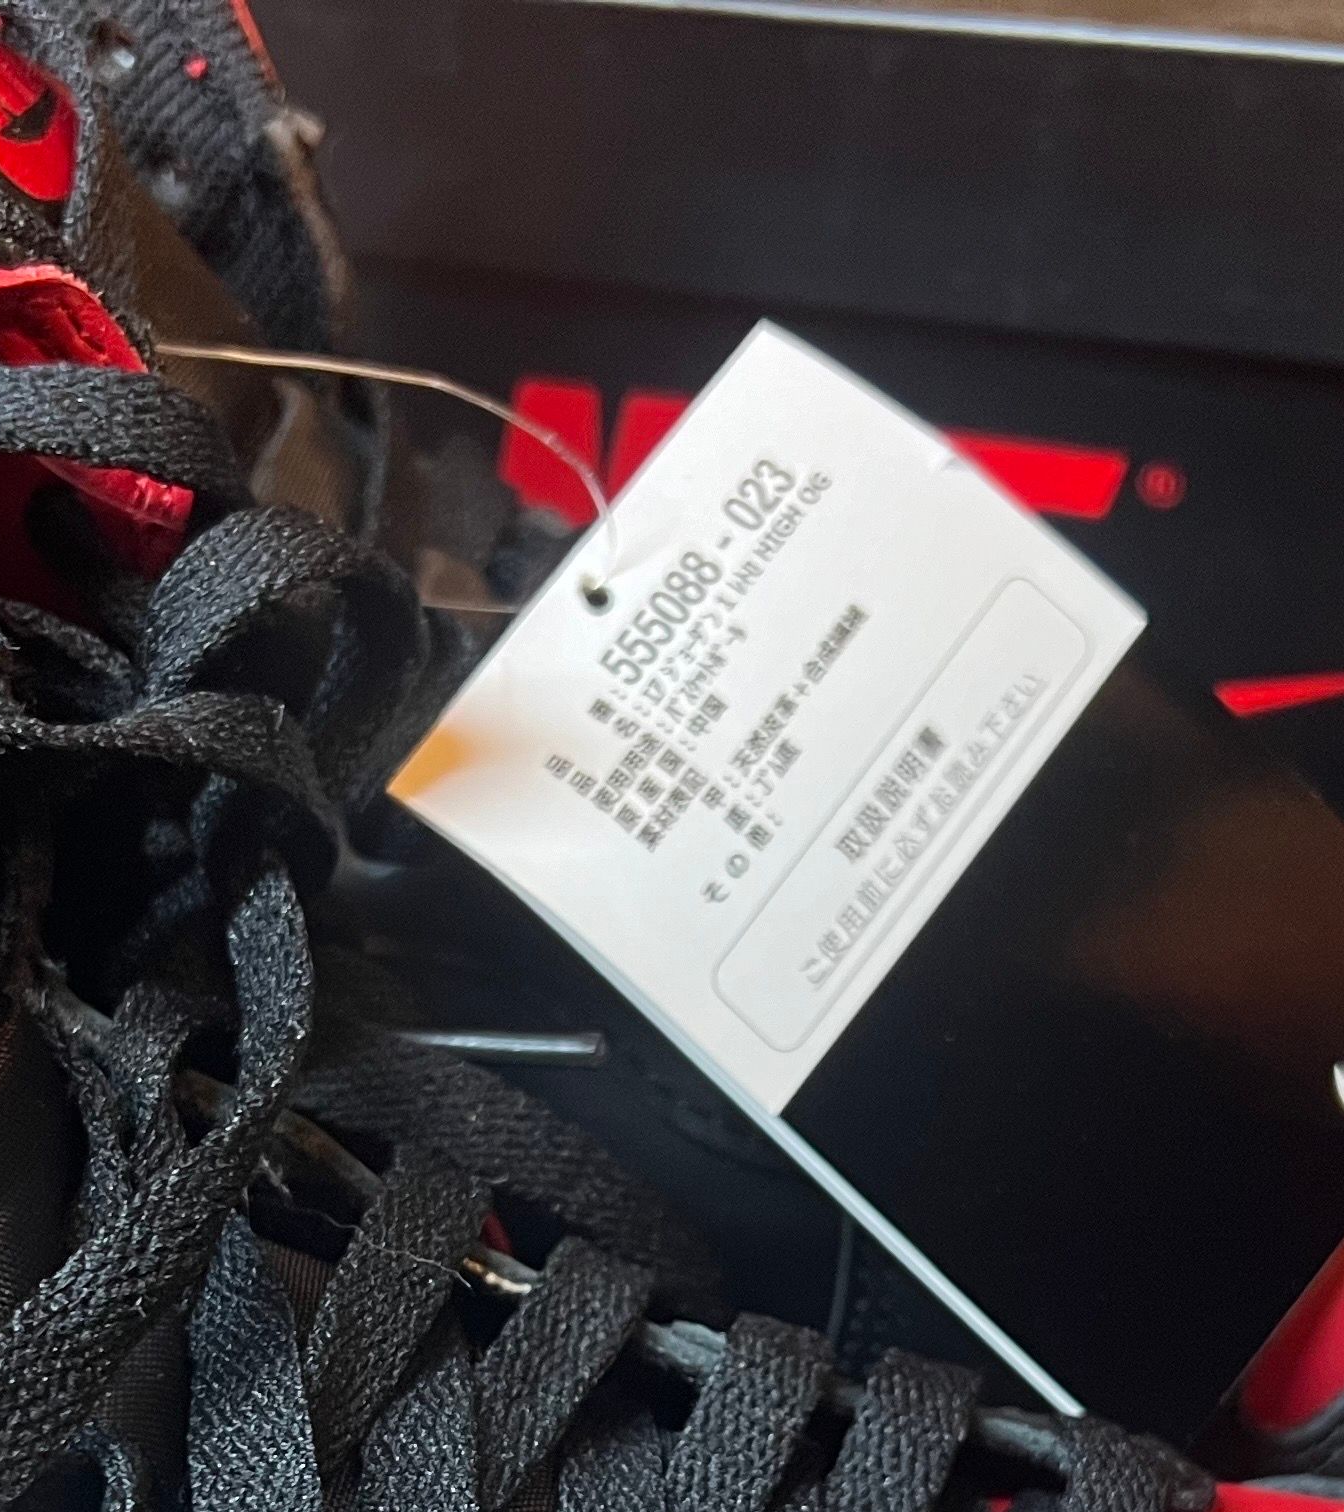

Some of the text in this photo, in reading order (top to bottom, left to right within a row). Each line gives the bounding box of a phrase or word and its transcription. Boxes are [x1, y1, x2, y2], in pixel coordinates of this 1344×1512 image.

[598, 551, 723, 685] 555088
[722, 459, 796, 531] 023
[752, 503, 806, 562] HIGH
[797, 471, 832, 505] OG
[834, 725, 948, 864] 取扱説明書
